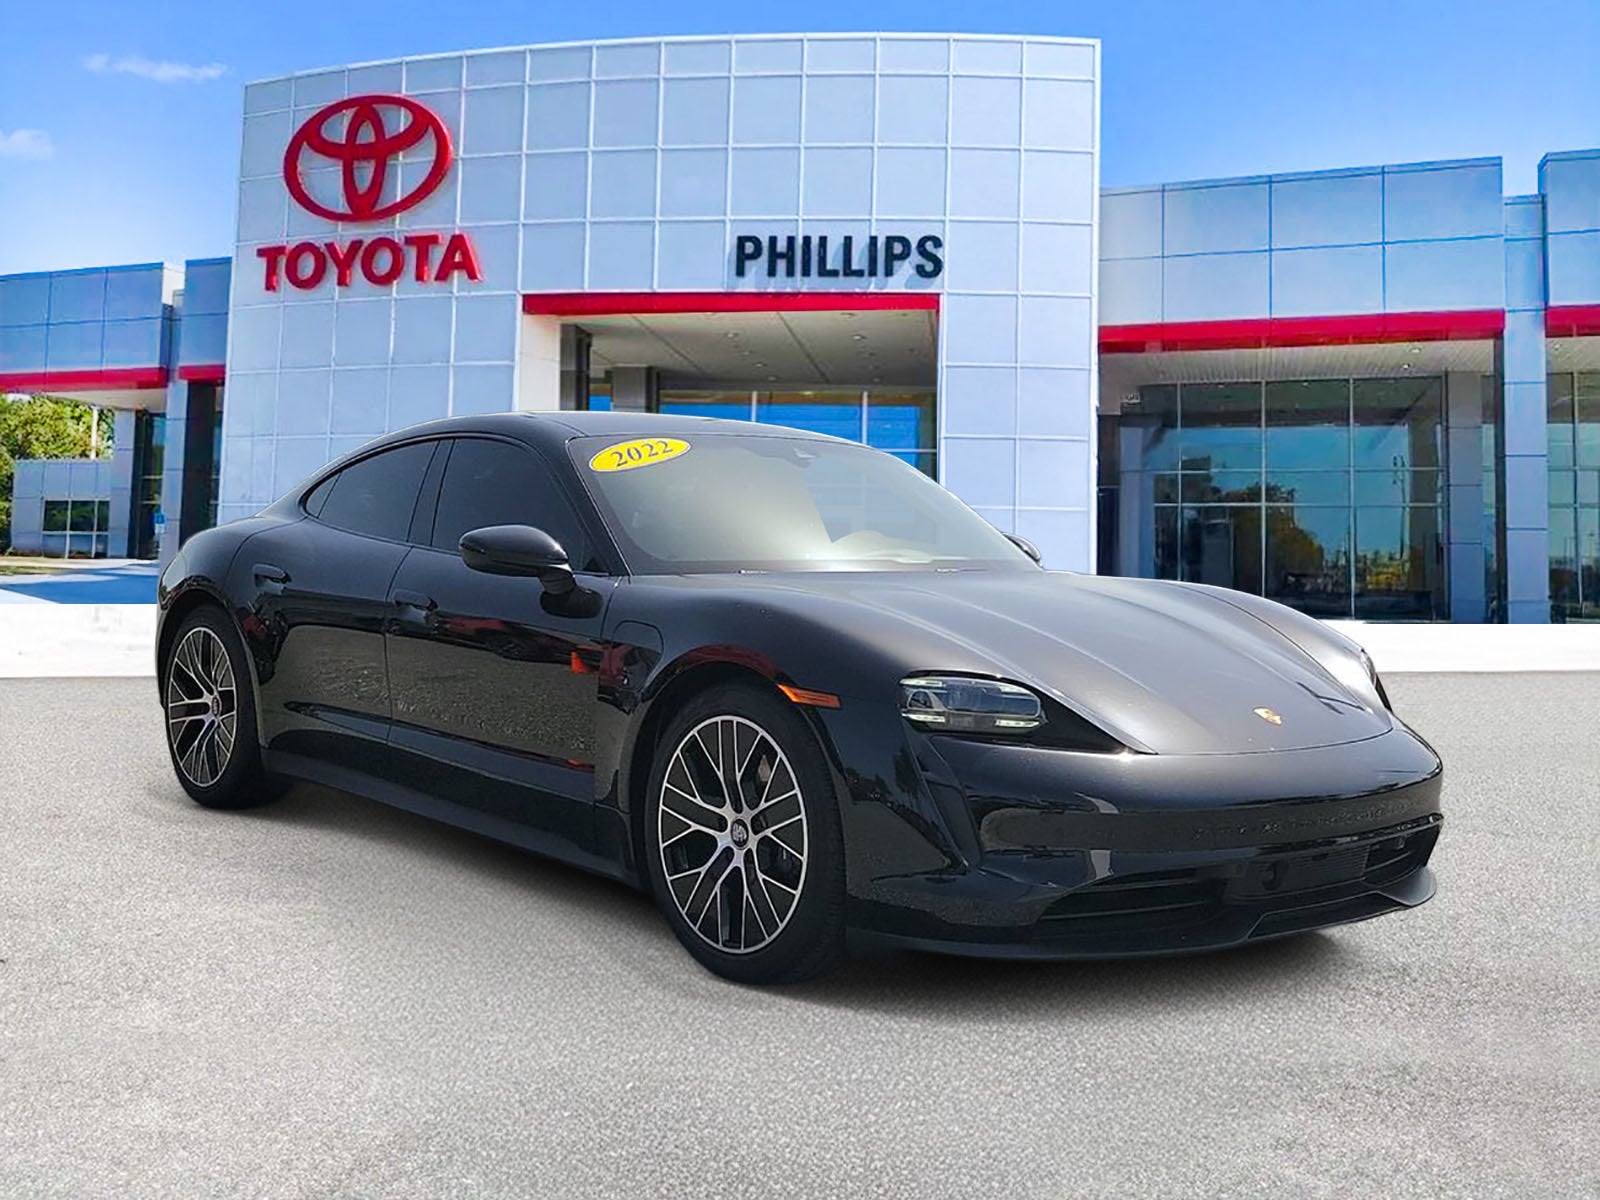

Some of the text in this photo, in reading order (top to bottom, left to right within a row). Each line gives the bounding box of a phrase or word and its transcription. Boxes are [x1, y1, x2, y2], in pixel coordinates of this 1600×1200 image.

[256, 233, 482, 292] TOYOTA
[735, 235, 944, 278] PHILLIPS
[610, 440, 674, 468] 2022
